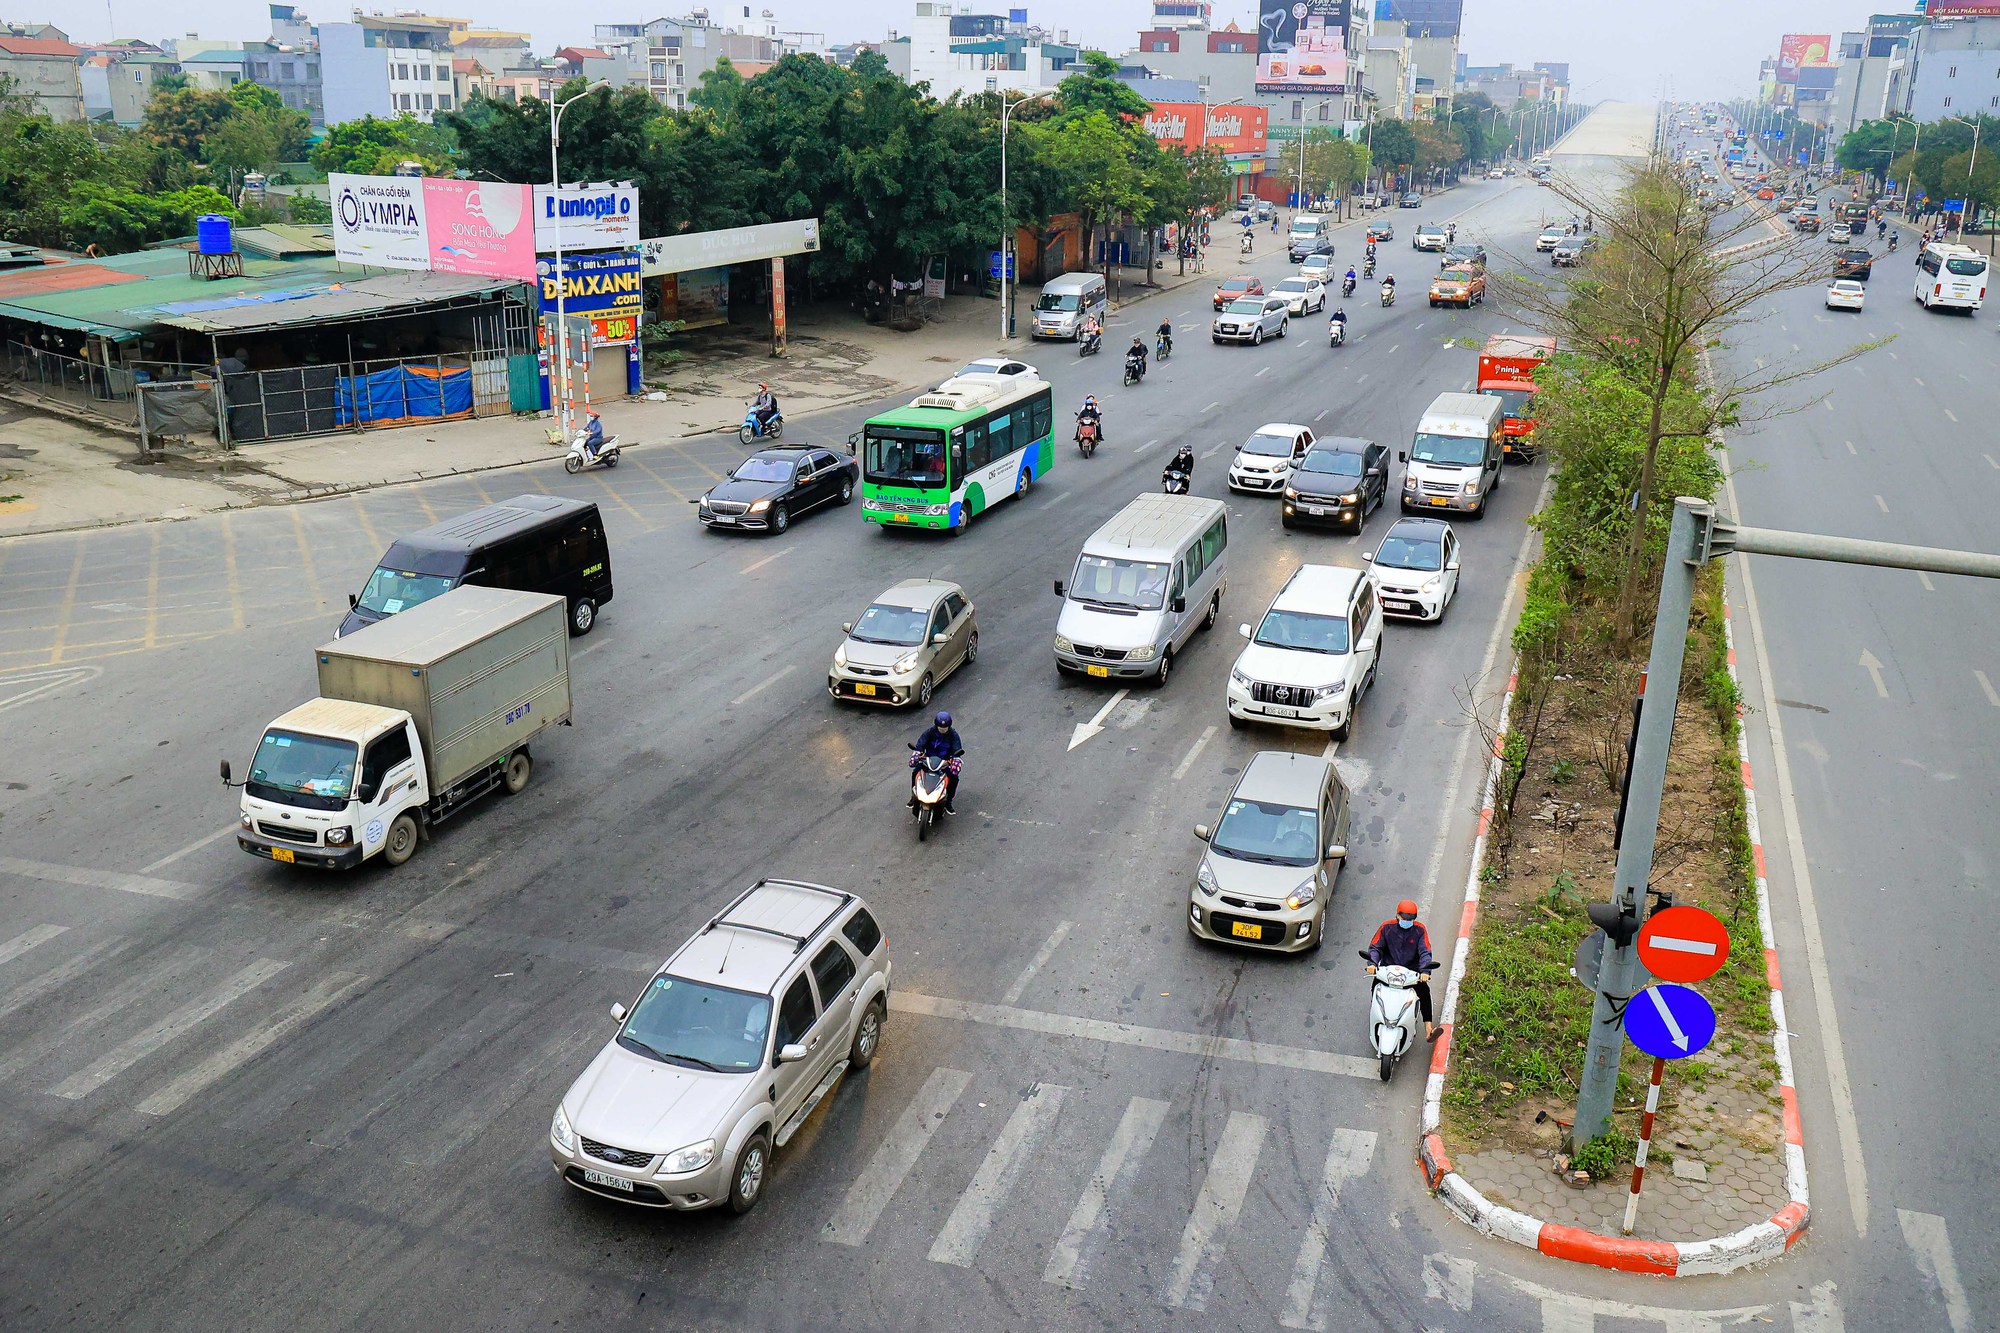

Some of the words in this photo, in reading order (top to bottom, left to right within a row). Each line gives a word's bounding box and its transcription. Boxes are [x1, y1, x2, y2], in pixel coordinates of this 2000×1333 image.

[377, 187, 385, 197] GA
[386, 185, 397, 197] GỐI
[397, 186, 411, 199] ĐỆM
[341, 194, 418, 227] OLYMPIA
[451, 222, 477, 237] SONG
[610, 258, 626, 267] HÀNG
[612, 293, 640, 306] .com
[607, 319, 630, 338] 50%
